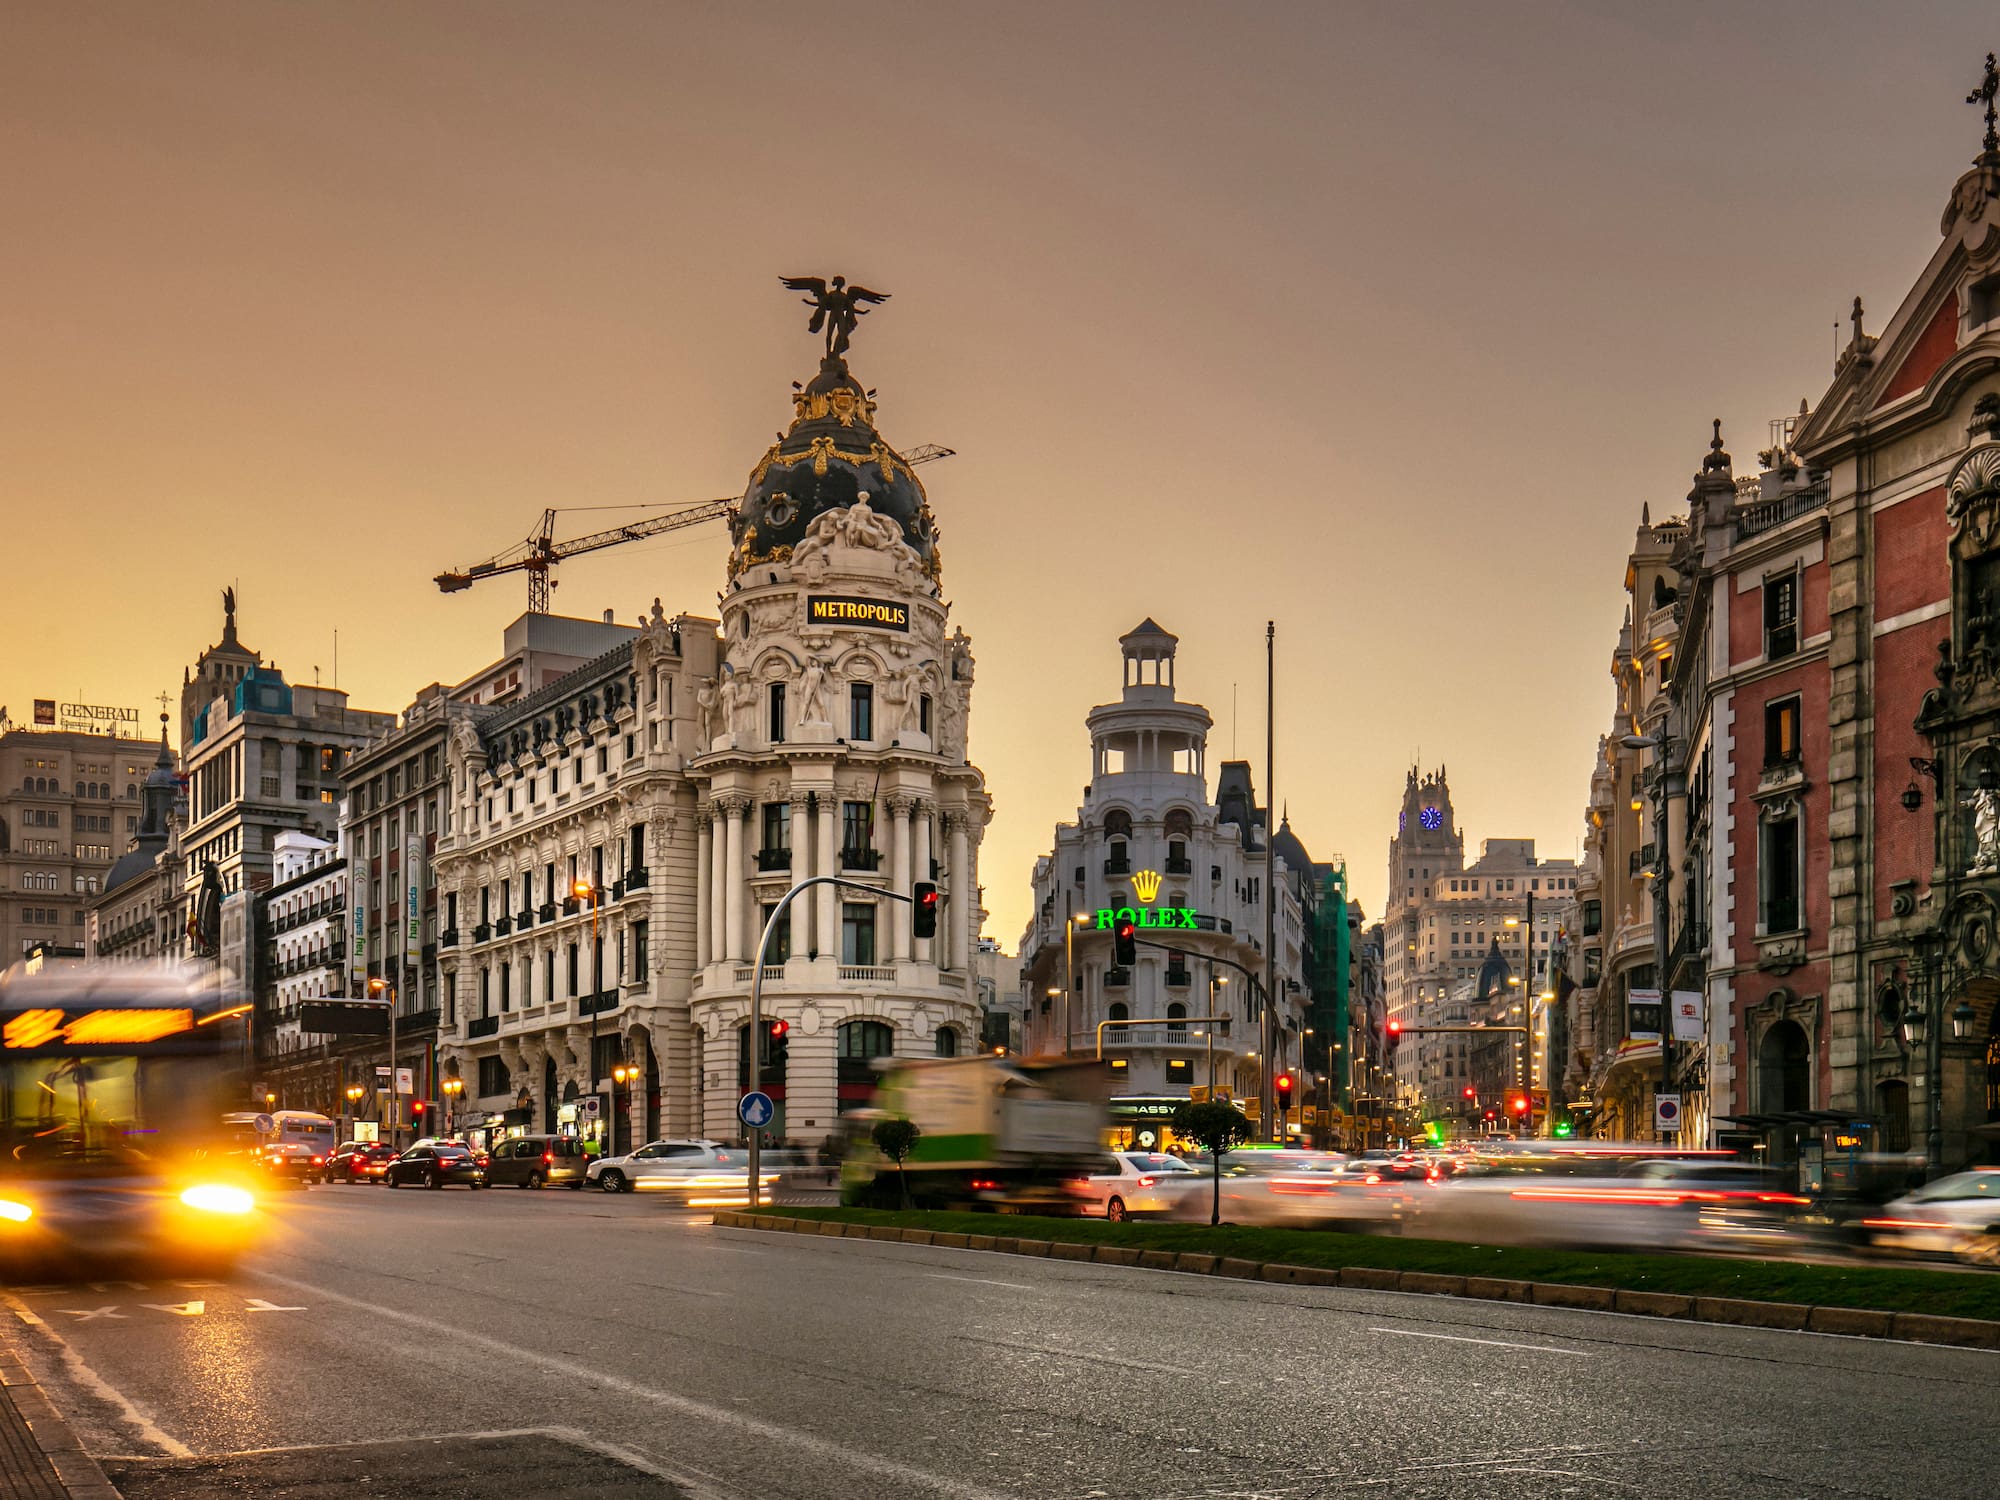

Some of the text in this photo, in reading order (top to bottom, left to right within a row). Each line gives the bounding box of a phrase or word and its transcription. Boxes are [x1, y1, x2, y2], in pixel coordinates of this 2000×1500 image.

[813, 602, 906, 624] METROPOLIS
[60, 703, 138, 721] GENERALI
[408, 886, 418, 917] salida
[354, 906, 364, 936] salida
[1096, 907, 1198, 929] ROLEX
[408, 919, 420, 939] hay
[354, 937, 366, 956] hay
[1116, 1105, 1177, 1114] ASSY
